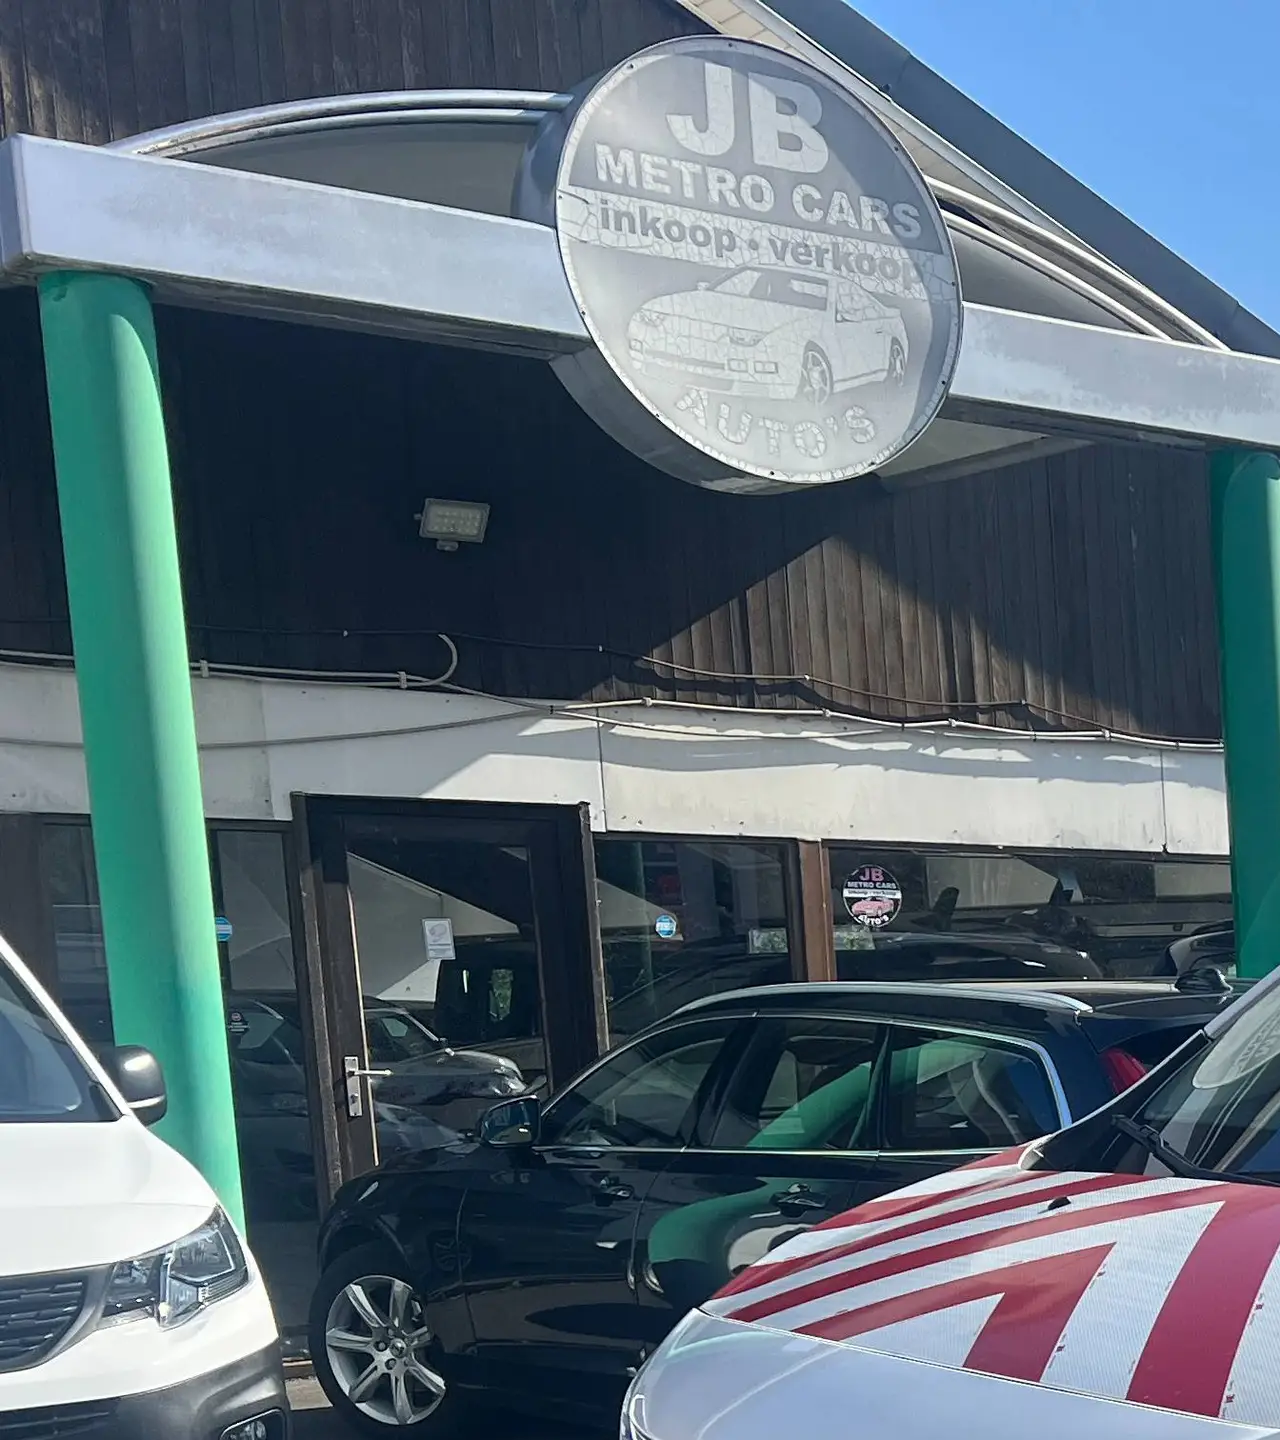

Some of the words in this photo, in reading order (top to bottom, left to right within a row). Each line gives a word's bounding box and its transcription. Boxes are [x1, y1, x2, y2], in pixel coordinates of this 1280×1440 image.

[666, 62, 829, 174] JB
[595, 143, 774, 213] METRO
[792, 183, 923, 240] CARS
[600, 199, 736, 258] inkoop
[768, 236, 921, 291] verkoop
[676, 388, 876, 459] AUTO'S
[847, 881, 874, 889] METRO
[875, 882, 897, 890] CARS
[859, 867, 884, 882] JB
